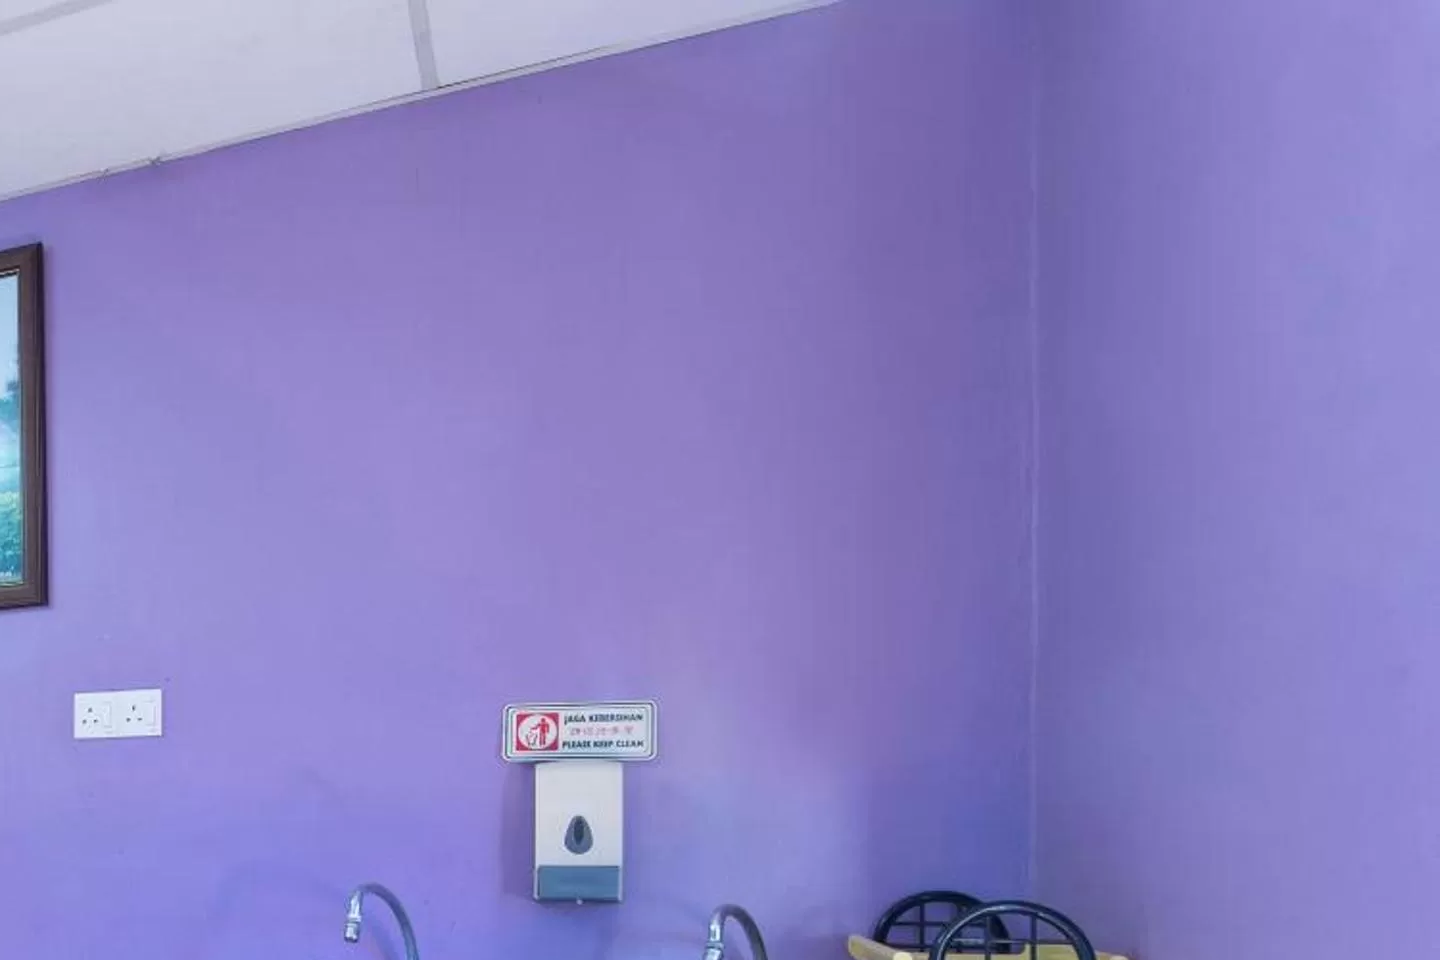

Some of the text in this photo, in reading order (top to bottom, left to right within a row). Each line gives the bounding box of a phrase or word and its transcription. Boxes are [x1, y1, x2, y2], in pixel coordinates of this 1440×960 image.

[564, 714, 586, 725] JAGA
[562, 740, 644, 749] PLEASE KEEP CLEAN
